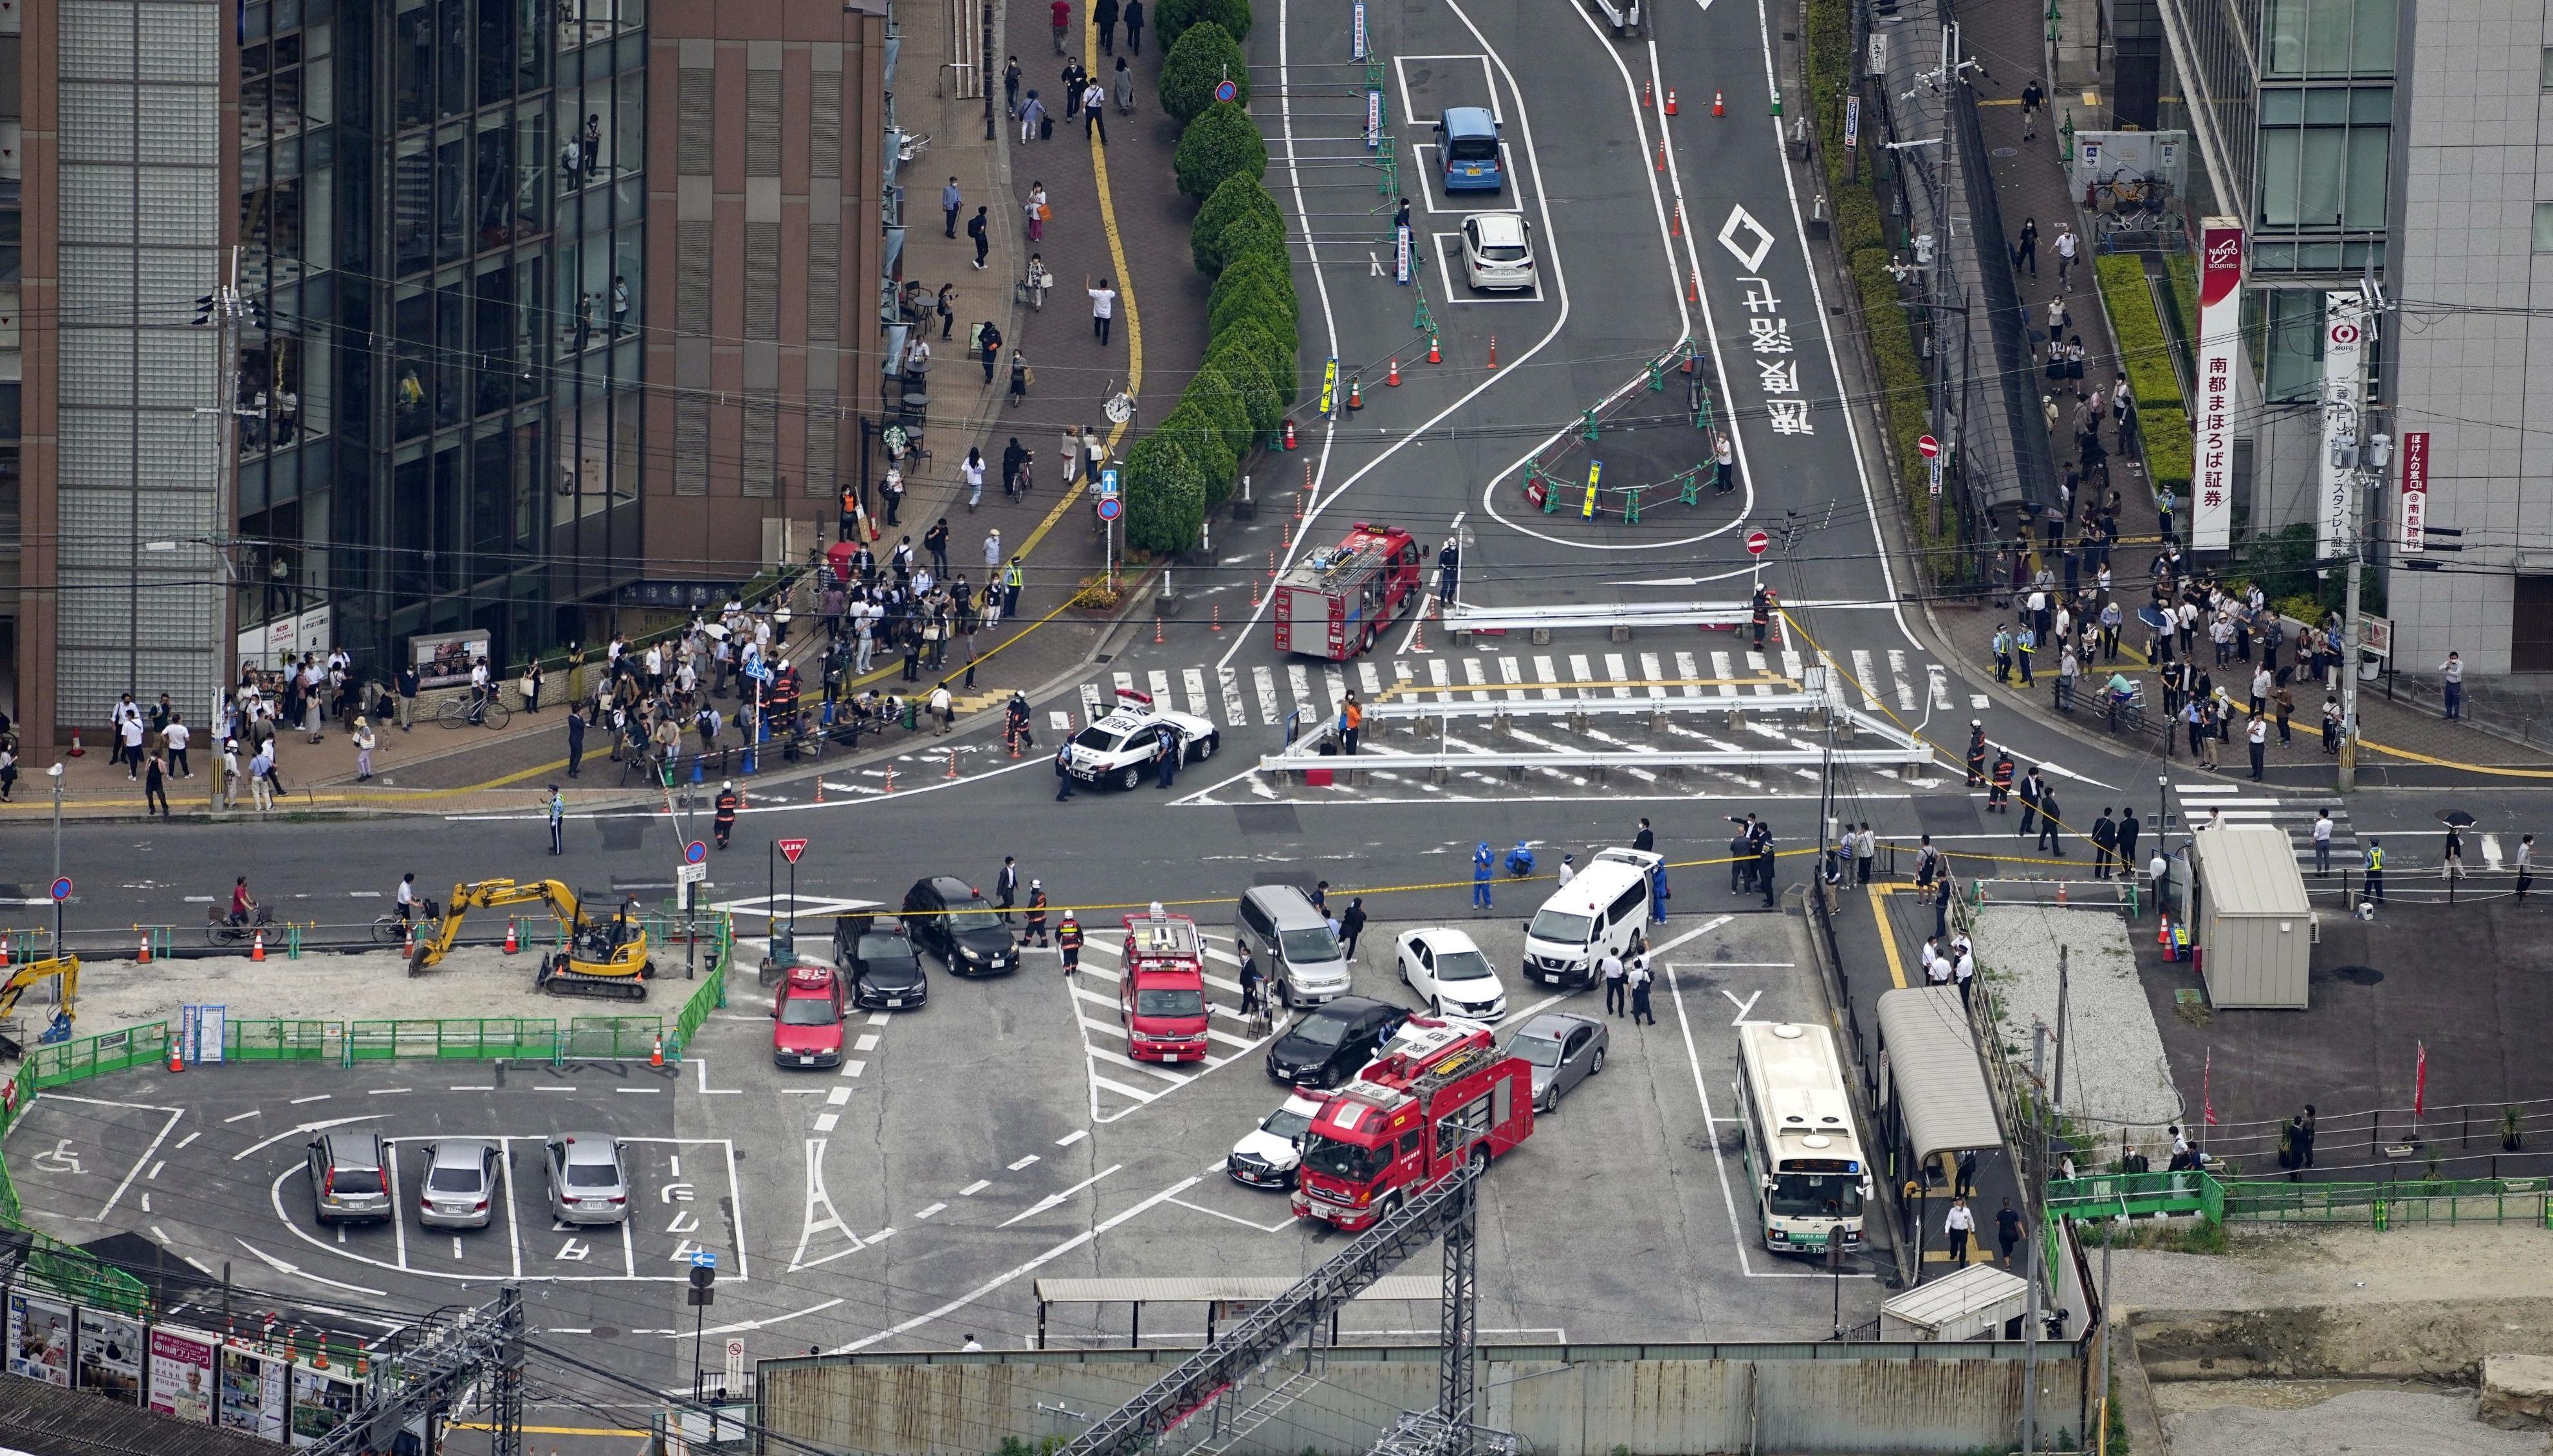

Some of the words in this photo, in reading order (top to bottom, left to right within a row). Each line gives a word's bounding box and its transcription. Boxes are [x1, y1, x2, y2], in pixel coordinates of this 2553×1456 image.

[2204, 357, 2227, 506] 南都まほろば証券
[2410, 435, 2421, 489] ほけんの窓口
[2407, 493, 2419, 549] @南都銀行
[1070, 770, 1094, 782] LICE
[162, 1344, 208, 1364] 川崎クリニック
